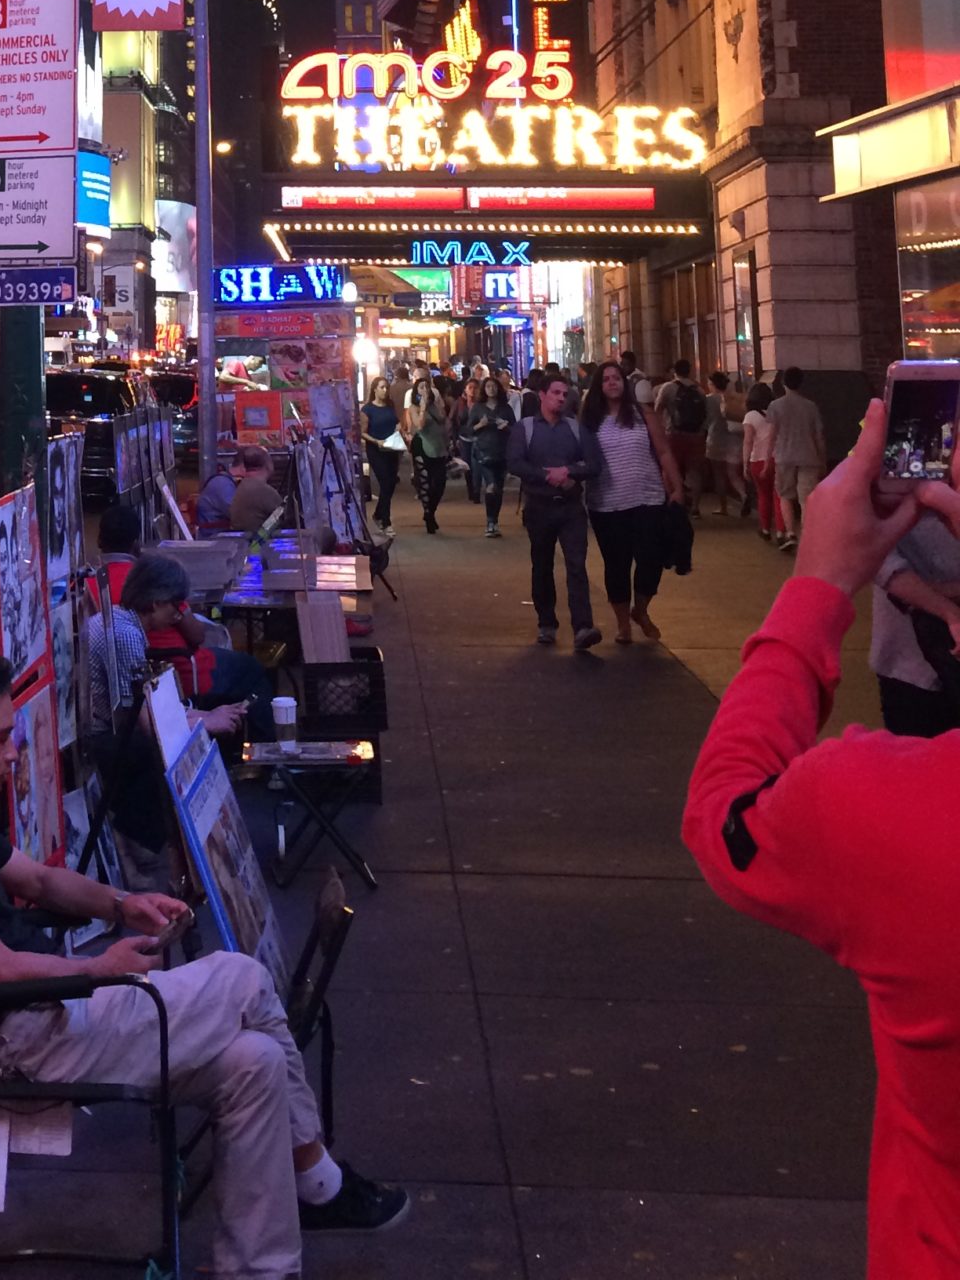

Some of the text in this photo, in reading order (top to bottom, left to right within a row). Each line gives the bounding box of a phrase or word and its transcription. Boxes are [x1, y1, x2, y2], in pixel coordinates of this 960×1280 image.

[9, 0, 25, 7] hour
[9, 6, 40, 17] metered
[9, 17, 36, 28] parking
[41, 49, 69, 64] ONLY
[20, 73, 31, 83] NO
[33, 70, 73, 82] STANDING
[281, 50, 574, 100] amc 25
[16, 91, 34, 103] 4pm
[16, 104, 47, 115] Sunday
[282, 104, 708, 170] THEATRES
[7, 161, 25, 170] hour
[7, 170, 39, 179] metered
[7, 180, 35, 192] parking
[12, 199, 48, 212] Midnight
[16, 213, 47, 225] Sunday
[412, 241, 530, 265] IMAX
